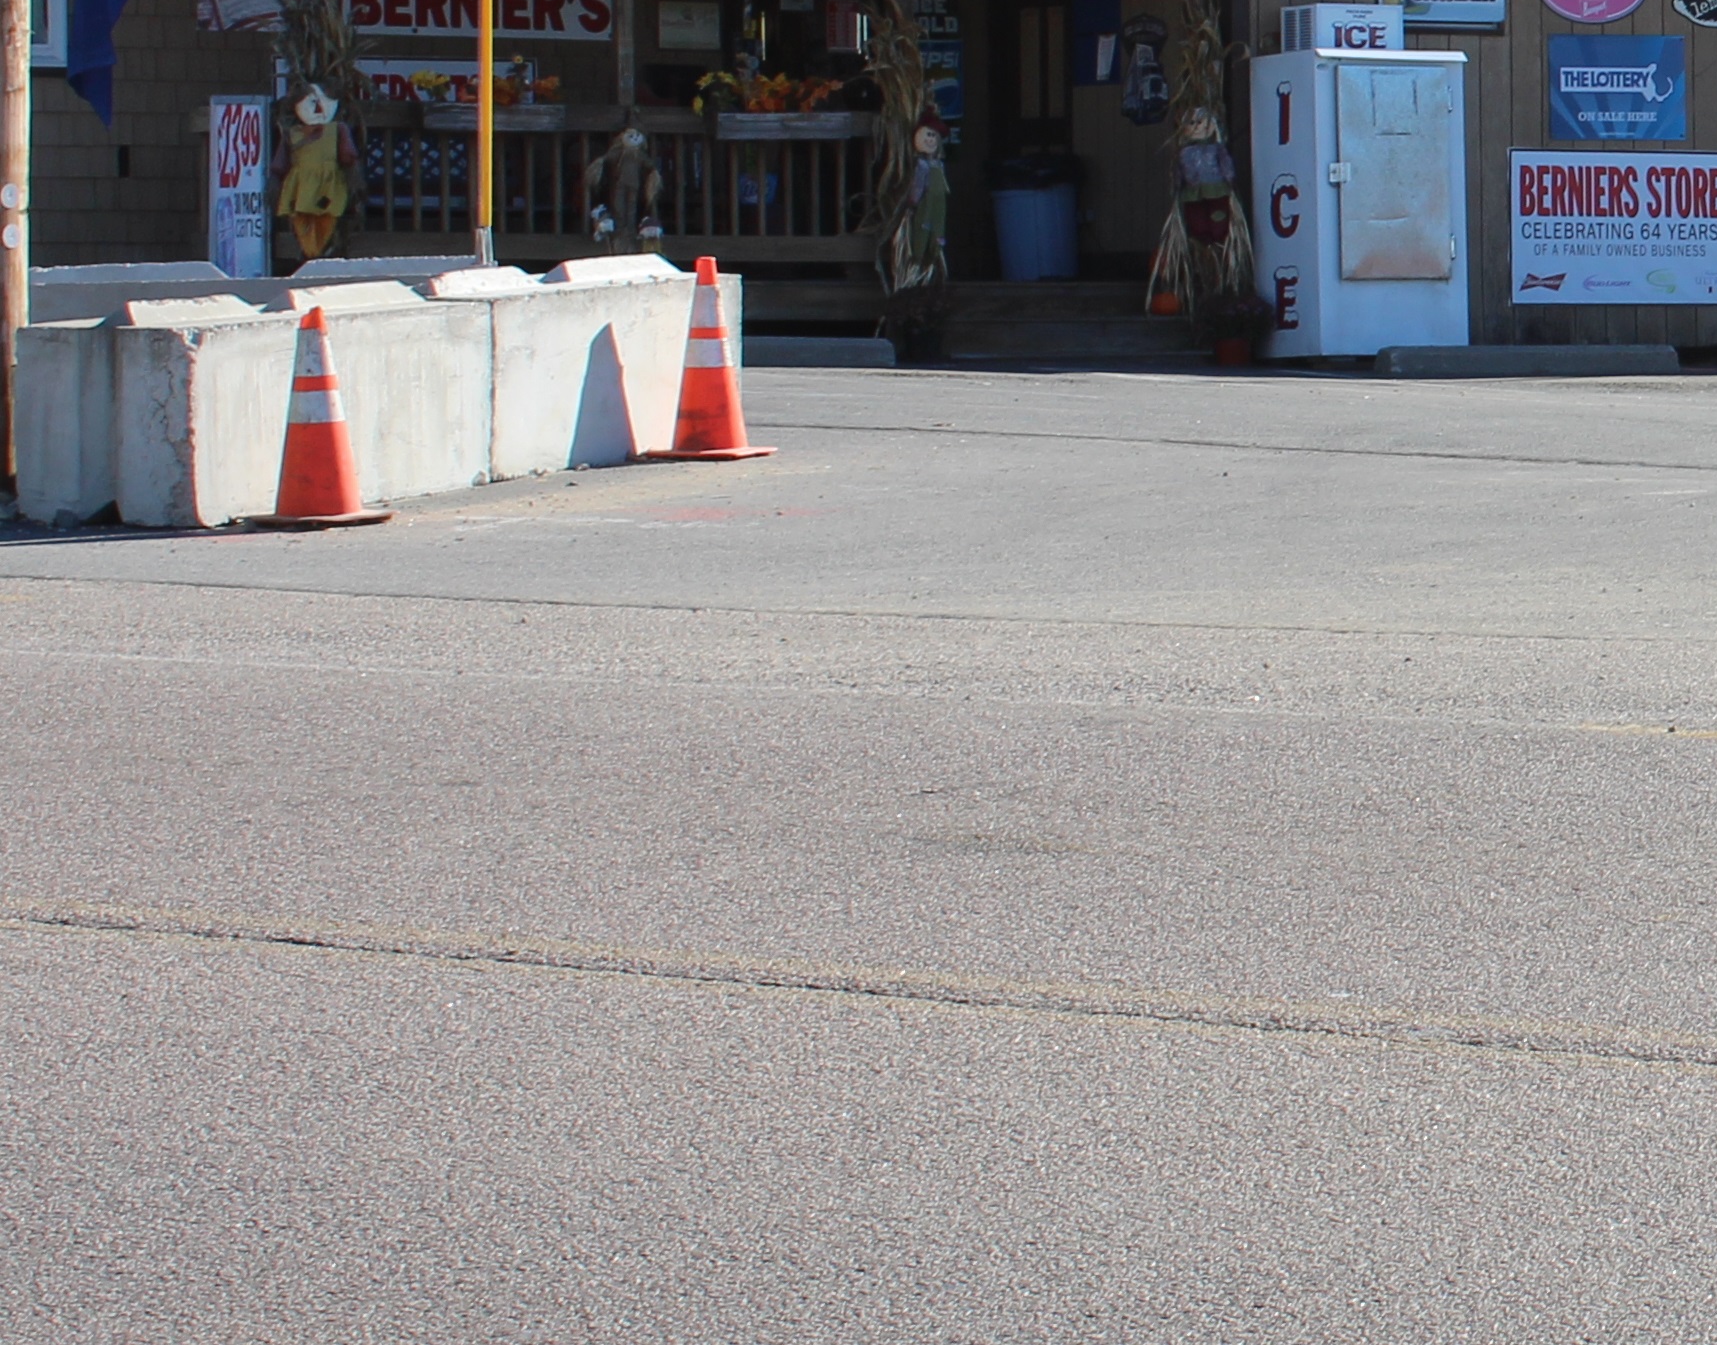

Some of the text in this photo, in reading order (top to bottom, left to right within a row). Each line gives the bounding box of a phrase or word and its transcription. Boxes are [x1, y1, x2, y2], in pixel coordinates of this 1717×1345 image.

[913, 16, 959, 33] OLD
[1332, 20, 1388, 50] ICE
[1591, 71, 1651, 88] LOTTERY
[1577, 112, 1658, 122] ON SALE HERE
[1519, 164, 1640, 218] BERNIERS
[1521, 221, 1634, 239] CELEBRATING
[1640, 222, 1661, 239] 64
[1533, 243, 1706, 257] OF A FAMILY OWNED BUSINESS
